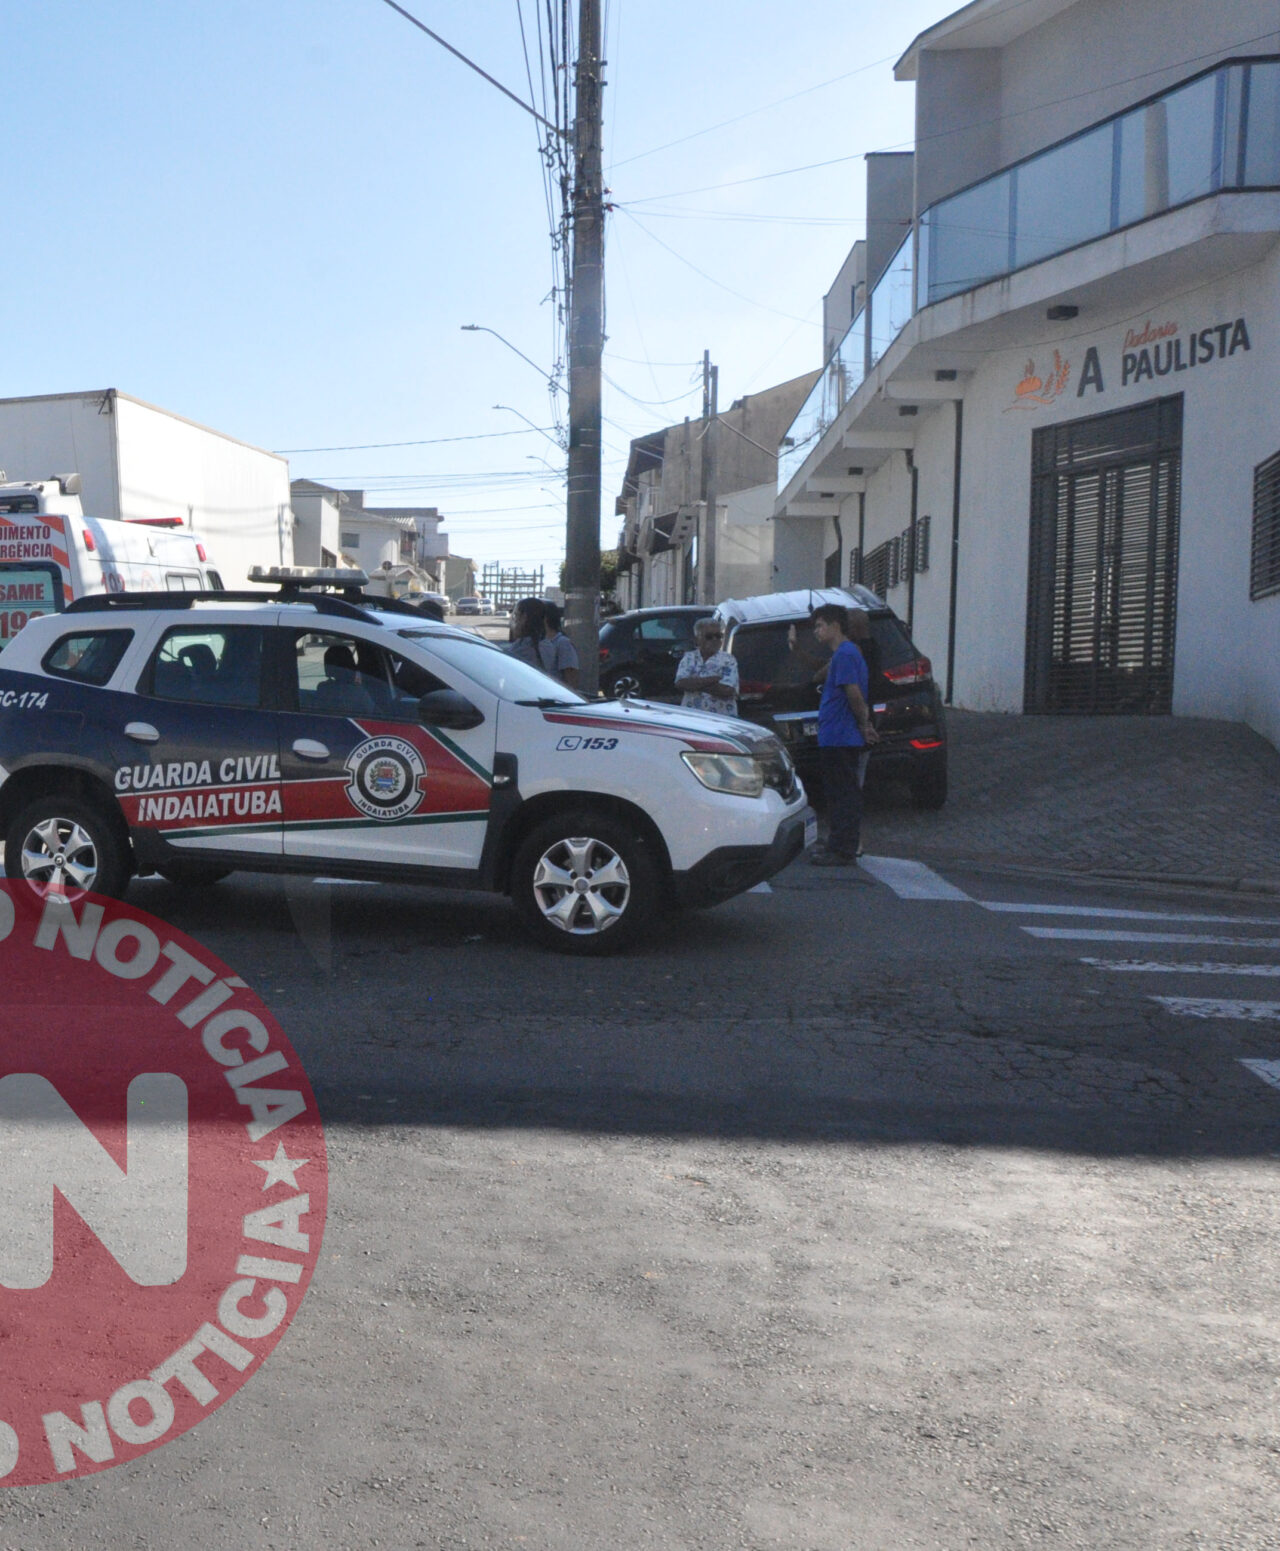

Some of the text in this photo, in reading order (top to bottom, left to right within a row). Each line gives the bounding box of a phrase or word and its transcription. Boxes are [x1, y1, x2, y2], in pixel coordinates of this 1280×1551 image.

[1076, 318, 1251, 398] A PAULISTA
[357, 742, 417, 763] GUARDA CIVIL
[582, 738, 618, 750] 153
[114, 754, 281, 790] GUARDA CIVIL
[137, 789, 283, 821] INDAIATUBA
[358, 800, 409, 816] INDAIATUBA
